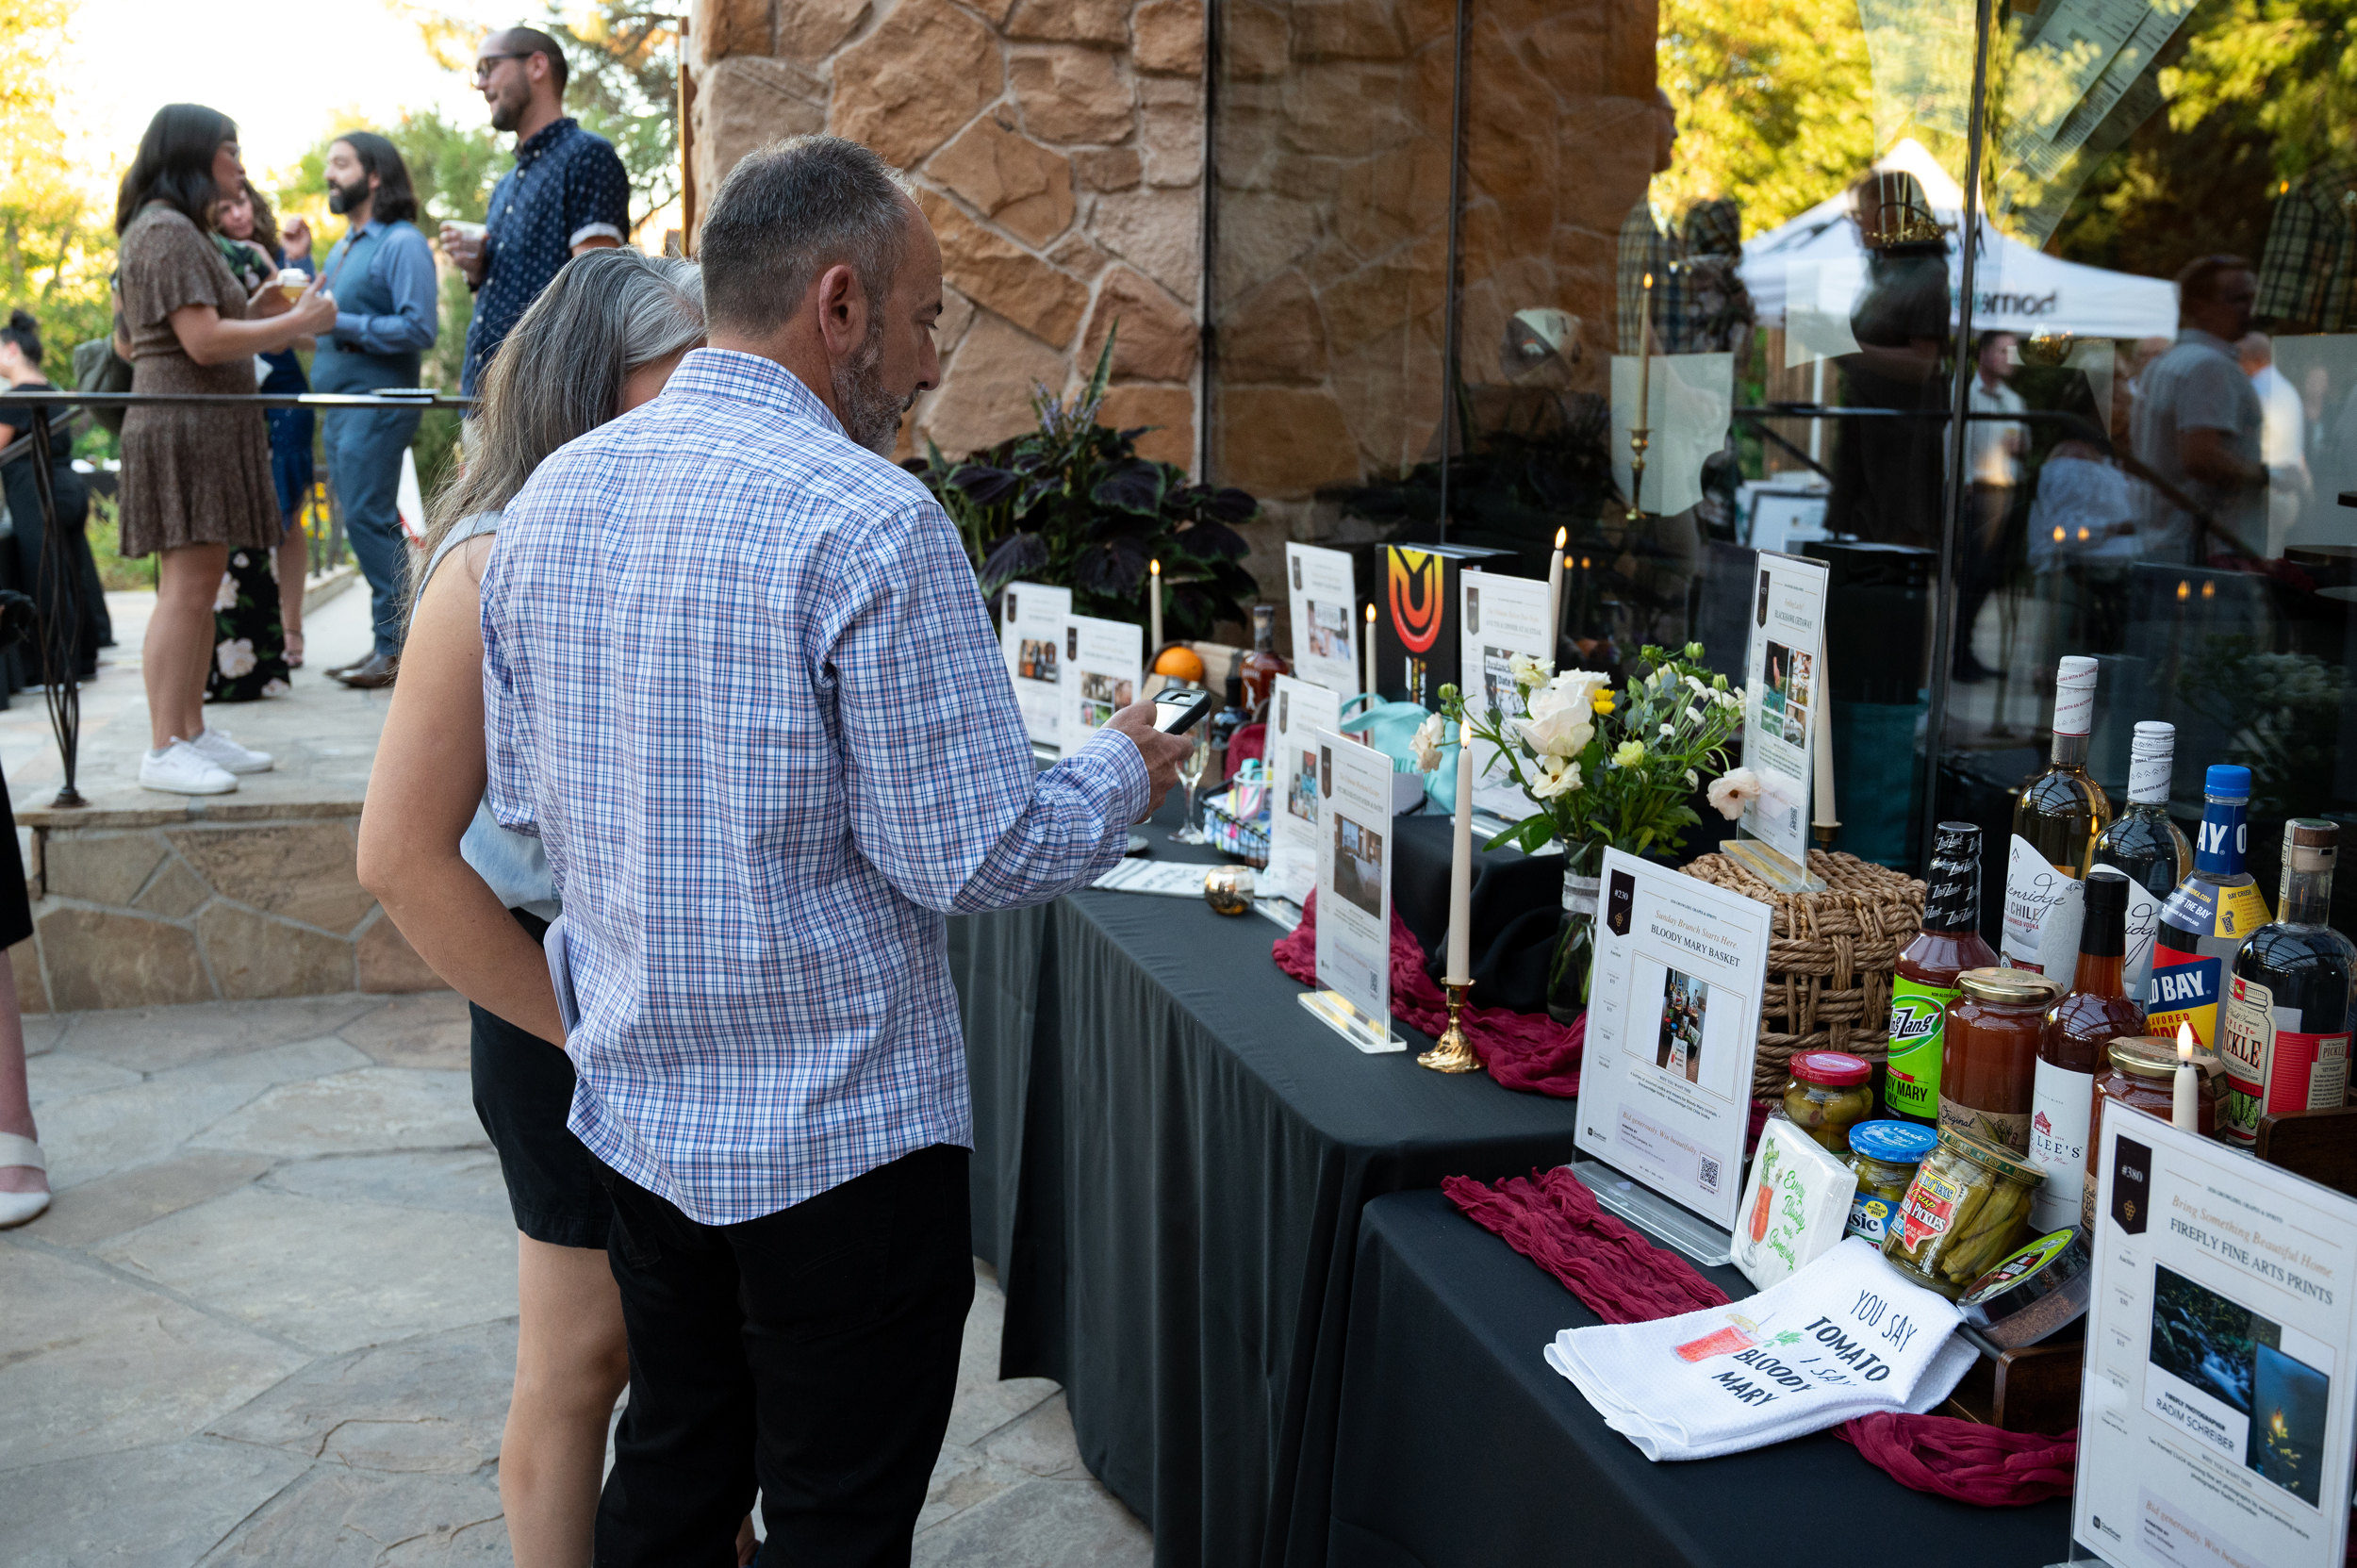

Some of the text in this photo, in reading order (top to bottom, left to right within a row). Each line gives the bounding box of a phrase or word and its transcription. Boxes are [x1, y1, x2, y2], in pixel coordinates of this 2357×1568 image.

[1614, 888, 1629, 901] #230
[2184, 899, 2199, 913] THE
[2195, 906, 2212, 919] BAY
[2227, 889, 2252, 900] BAY CRUSH
[2010, 901, 2040, 921] CHILE
[2023, 921, 2039, 931] VODKA
[1651, 924, 1740, 967] BLOODY MARY BASKET
[1655, 910, 1739, 950] Sunday Brunch Starts Here.
[2161, 970, 2205, 1002] BAY
[2234, 1064, 2251, 1074] VODKA
[1897, 1081, 1928, 1102] MARY
[1622, 1111, 1631, 1122] Bid
[1631, 1116, 1658, 1135] generously.
[1659, 1130, 1670, 1140] Win
[1671, 1135, 1698, 1156] beautifully.
[1940, 1105, 1976, 1130] Original
[1949, 1136, 1971, 1154] DELICIOUS
[1984, 1154, 2002, 1168] CRISP
[2036, 1135, 2080, 1159] LEE'S
[1784, 1170, 1805, 1206] Every
[2121, 1164, 2144, 1183] #380
[1911, 1188, 1937, 1209] Crisp
[1934, 1180, 1954, 1201] TEXAS
[1782, 1195, 1805, 1234] Bloody
[1868, 1204, 1887, 1214] Artificial
[1913, 1201, 1947, 1232] PICKLES
[1767, 1228, 1796, 1272] Somebody
[2171, 1195, 2335, 1280] Bring Something Beautiful Home.
[2118, 1254, 2135, 1268] Auction
[2170, 1217, 2333, 1307] FIREFLY FINE ARTS PRINTS
[1850, 1289, 1918, 1352] YOU SAY
[1805, 1315, 1890, 1382] TOMATO
[1732, 1348, 1818, 1393] BLOODY
[1810, 1368, 1857, 1387] SAY
[1711, 1371, 1780, 1407] MARY
[2155, 1398, 2235, 1453] RADIM SCHREIBER
[2165, 1391, 2227, 1432] FIREFLY PHOTOGRAPHER
[2148, 1436, 2158, 1446] Two
[2159, 1442, 2173, 1455] framed
[2187, 1459, 2206, 1477] stunning
[2223, 1480, 2251, 1504] photographs
[2201, 1453, 2213, 1463] WHY
[2225, 1464, 2240, 1481] WANT
[2190, 1472, 2220, 1497] photographer
[2220, 1490, 2235, 1506] Radim
[2145, 1499, 2160, 1516] Bid
[2160, 1510, 2201, 1544] generously.
[2204, 1535, 2220, 1556] Win
